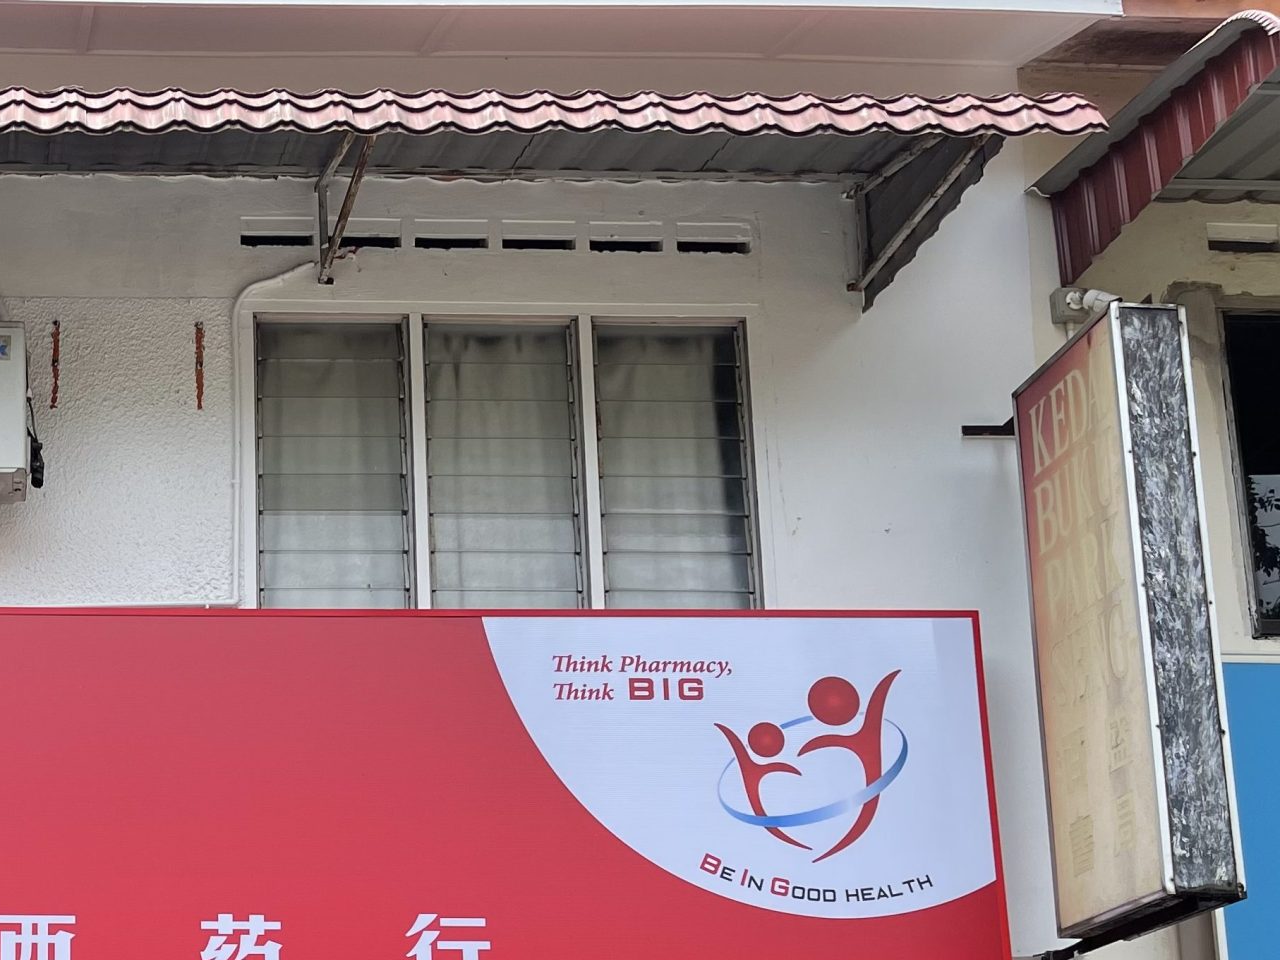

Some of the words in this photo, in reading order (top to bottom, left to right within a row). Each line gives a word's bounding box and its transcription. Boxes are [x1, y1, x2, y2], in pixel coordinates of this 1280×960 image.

[1029, 347, 1113, 477] KEDA
[553, 655, 613, 673] Think
[618, 655, 732, 679] Pharmacy,
[553, 683, 614, 701] Think
[629, 678, 704, 700] BIG
